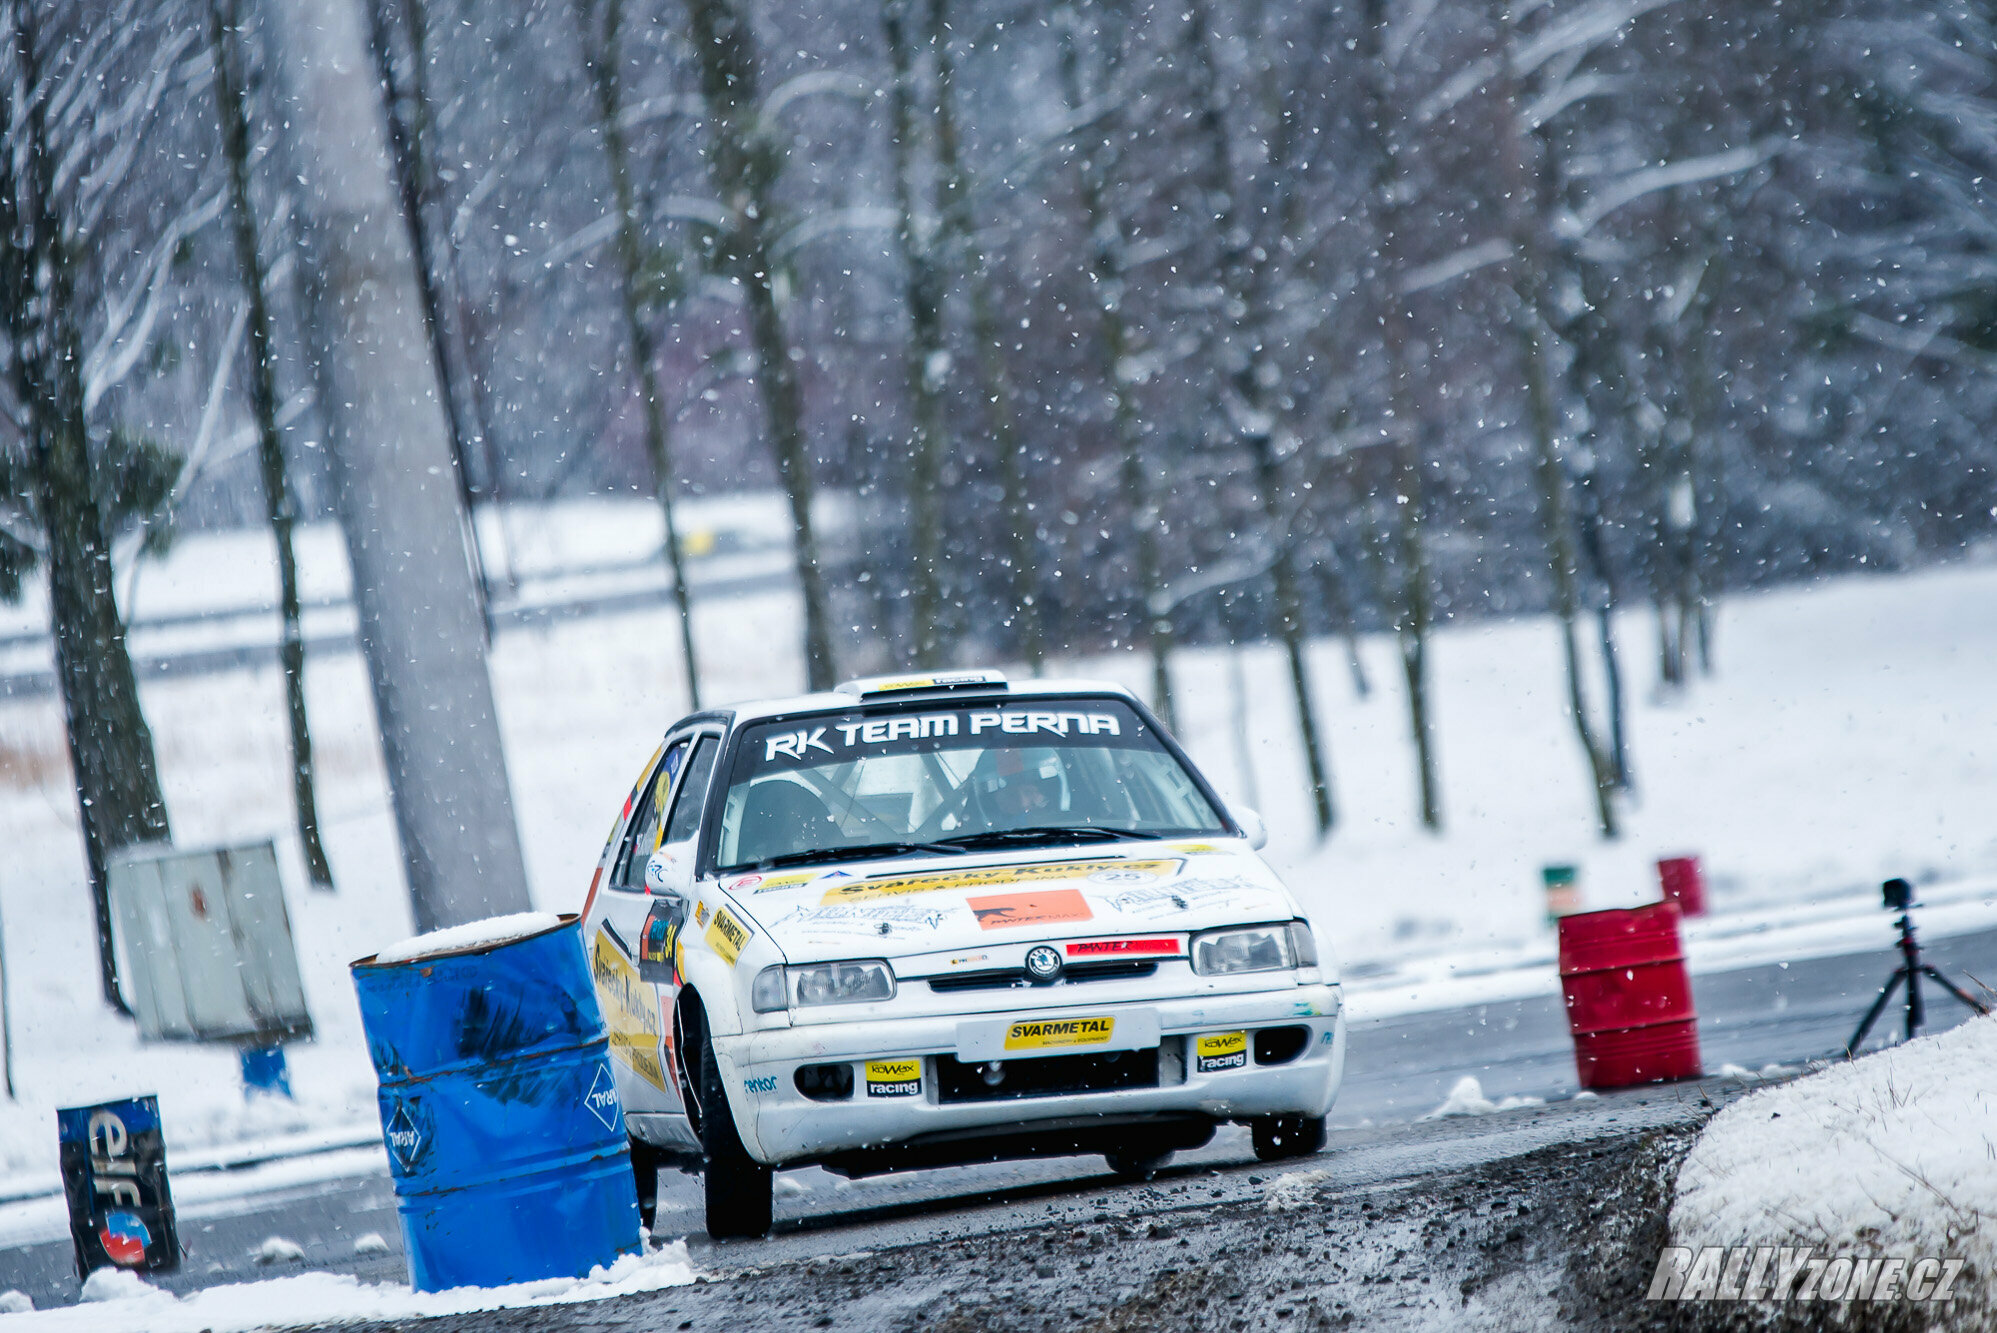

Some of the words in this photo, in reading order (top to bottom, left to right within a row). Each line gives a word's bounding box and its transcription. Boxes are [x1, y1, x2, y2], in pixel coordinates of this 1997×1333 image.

[765, 725, 835, 761] RK
[835, 713, 958, 747] TEAM
[970, 709, 1121, 738] PERNA
[713, 909, 746, 952] SVARMETAL
[1011, 1020, 1110, 1038] SVARMETAL
[1202, 1053, 1245, 1068] racing
[870, 1082, 919, 1095] racing
[388, 1130, 415, 1148] ARAL
[88, 1110, 143, 1208] elf
